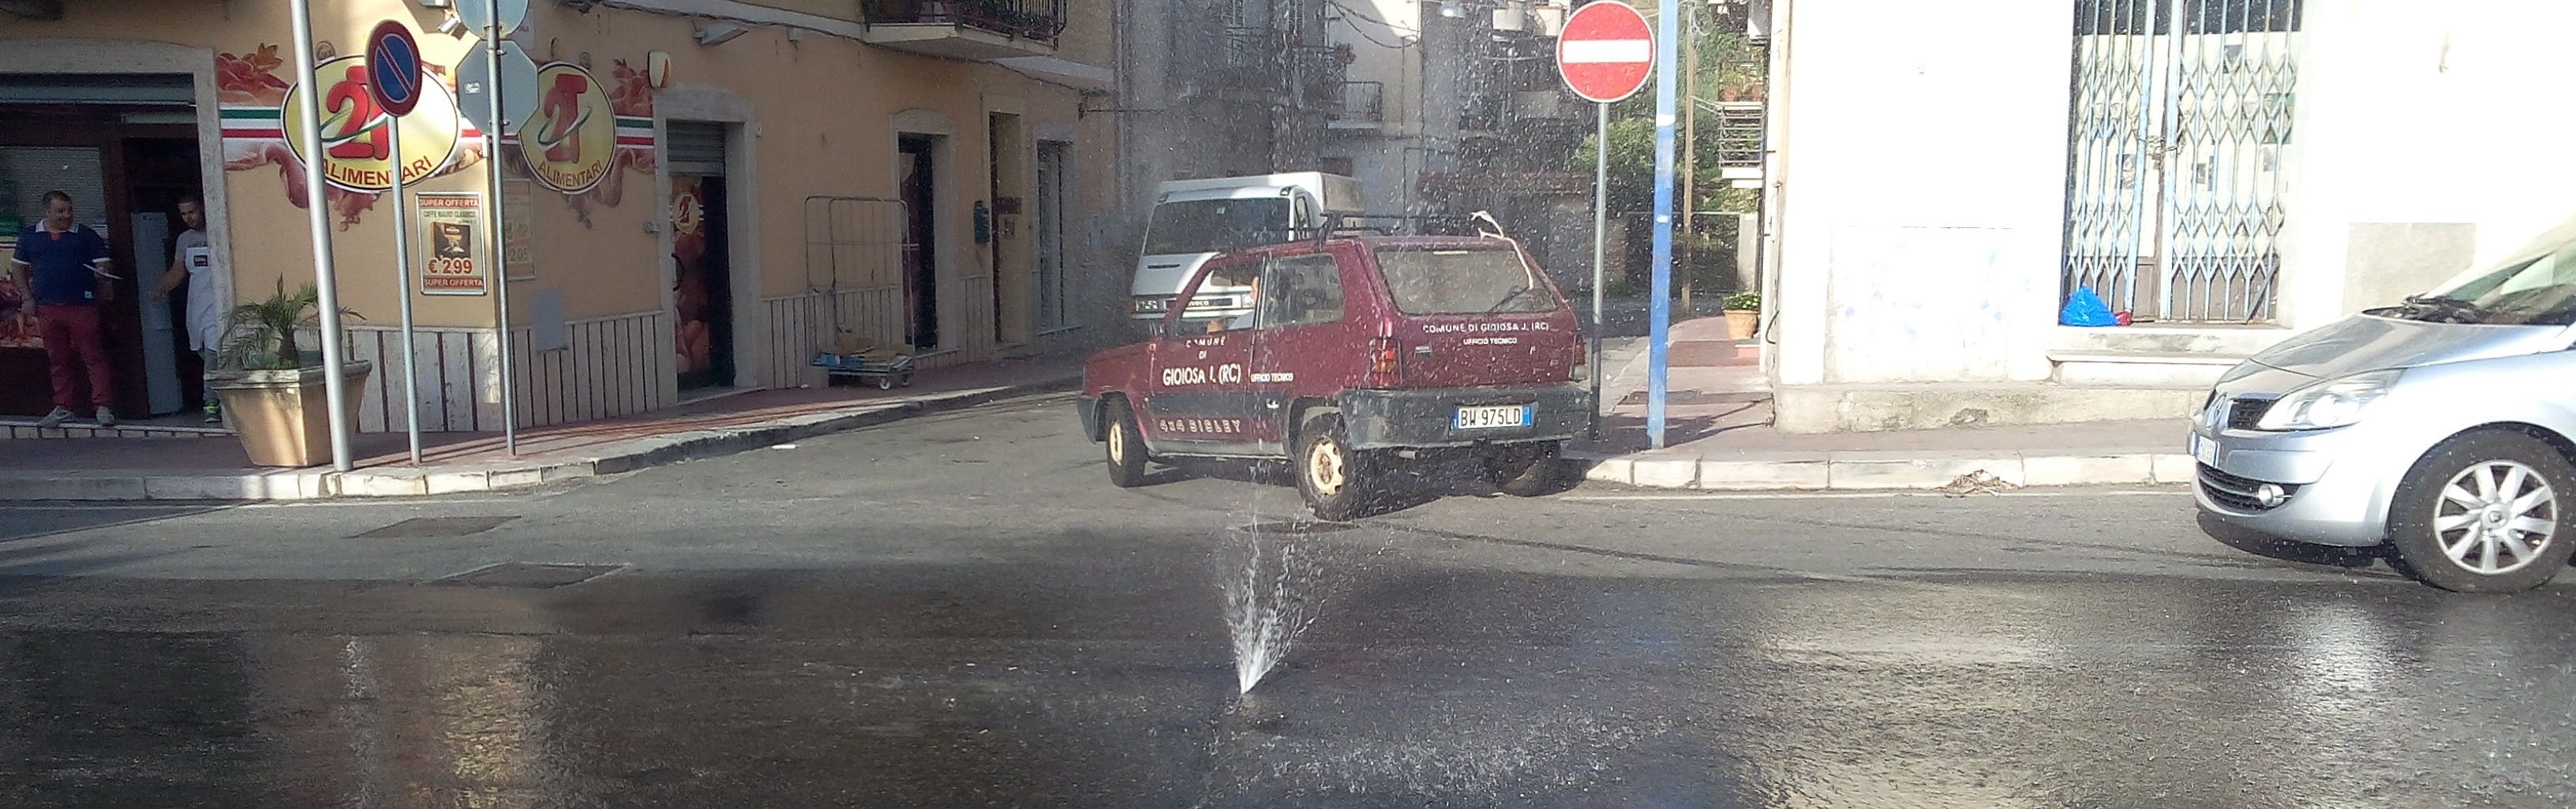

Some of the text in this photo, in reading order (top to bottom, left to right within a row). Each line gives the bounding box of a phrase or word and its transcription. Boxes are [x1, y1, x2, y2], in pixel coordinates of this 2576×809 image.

[322, 155, 432, 186] ALIMENARI
[537, 159, 604, 187] ALIMENTARI
[429, 260, 437, 273] €
[1422, 323, 1466, 333] COMUNE
[1468, 324, 1478, 332] DI
[1481, 323, 1518, 332] GIOIOSA
[1531, 321, 1549, 331] (RC)
[1198, 350, 1208, 360] DI
[1163, 366, 1206, 386] GIOIOSA
[1219, 363, 1241, 385] (RC)
[1250, 372, 1294, 383] UFFICIO TECNICO
[1461, 407, 1521, 427] BW 975LD
[1159, 419, 1241, 433] 4x4 SISLEY
